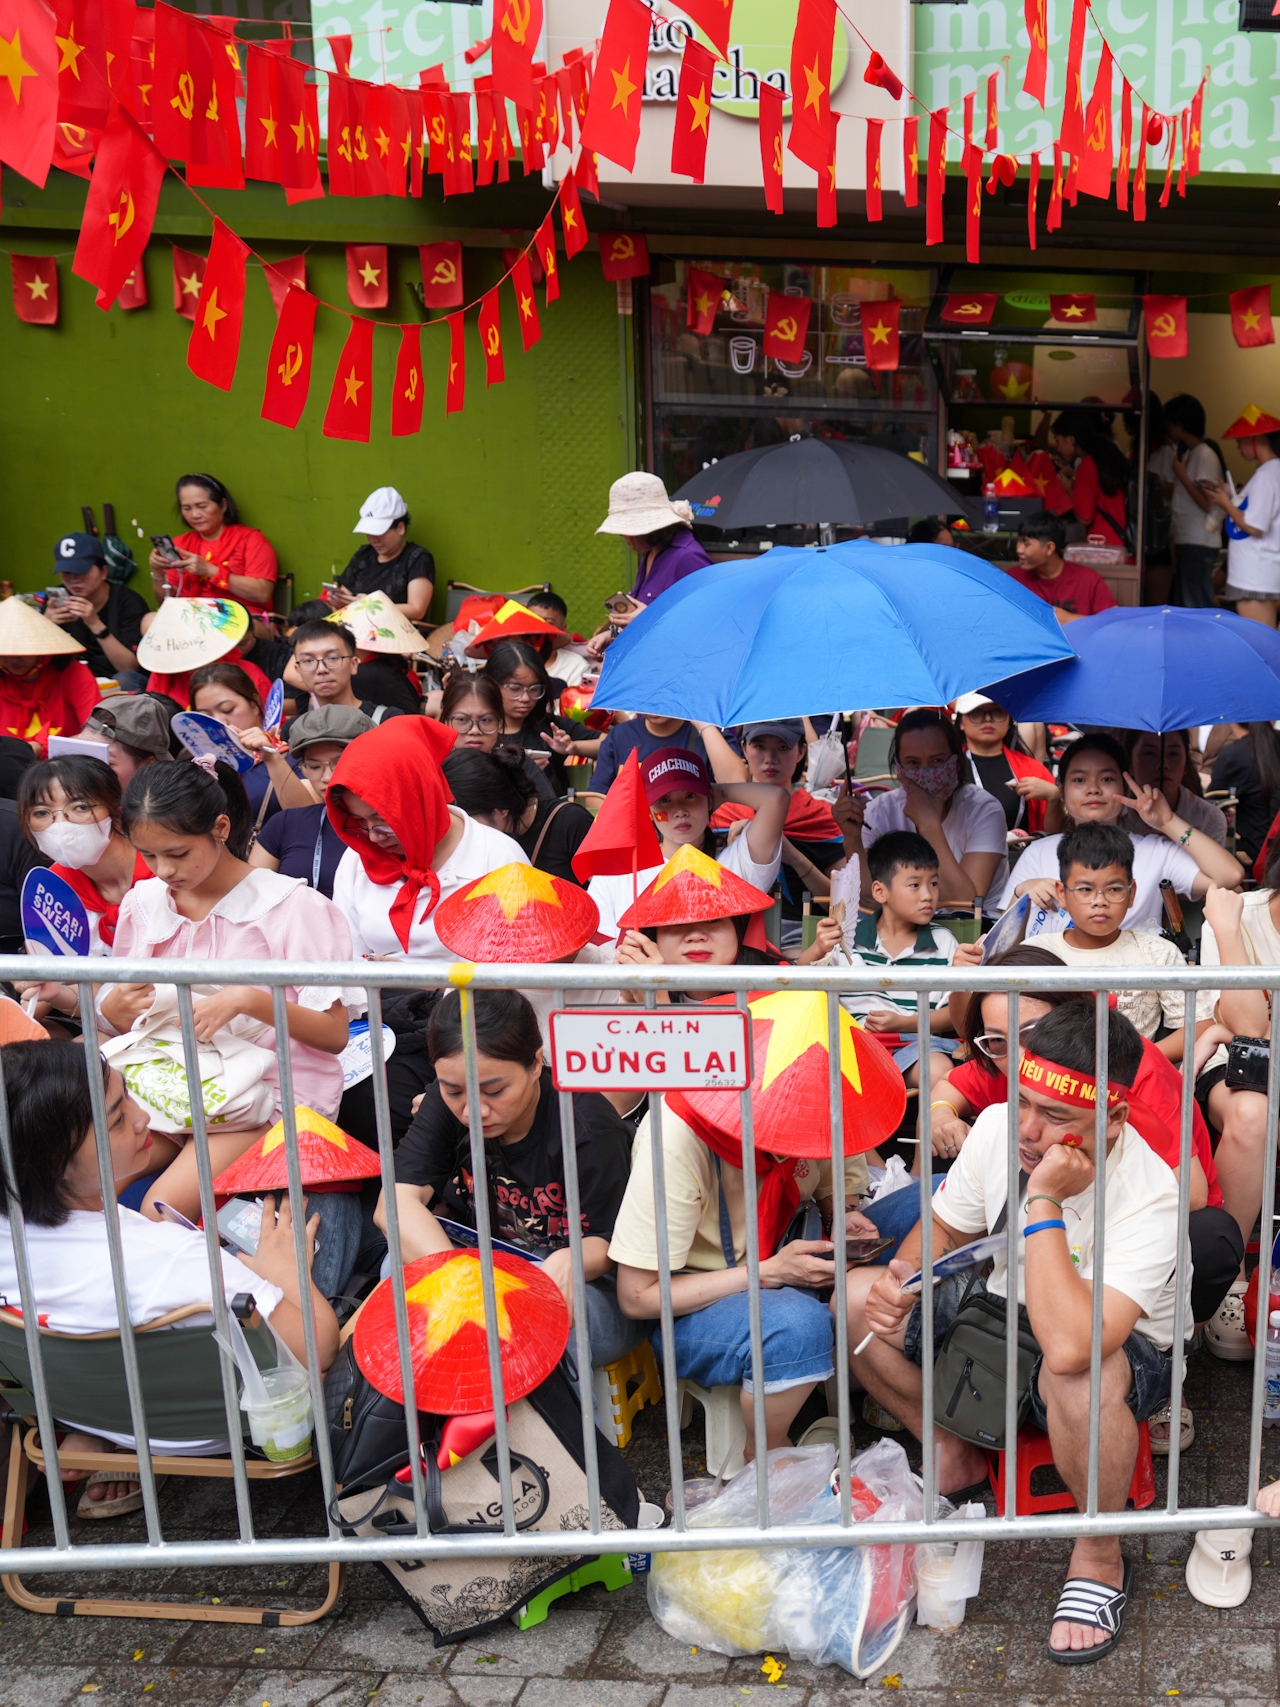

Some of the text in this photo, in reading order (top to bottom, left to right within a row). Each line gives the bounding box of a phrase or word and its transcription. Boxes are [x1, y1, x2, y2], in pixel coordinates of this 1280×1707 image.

[60, 538, 76, 558] C
[648, 758, 700, 783] CHACHING
[33, 894, 77, 943] SWEAT
[36, 882, 83, 938] POCARI
[607, 1019, 701, 1035] C.A.H.N
[565, 1042, 737, 1079] DỪNG LẠI
[704, 1078, 737, 1087] 25632
[1045, 1070, 1080, 1096] VIỆT
